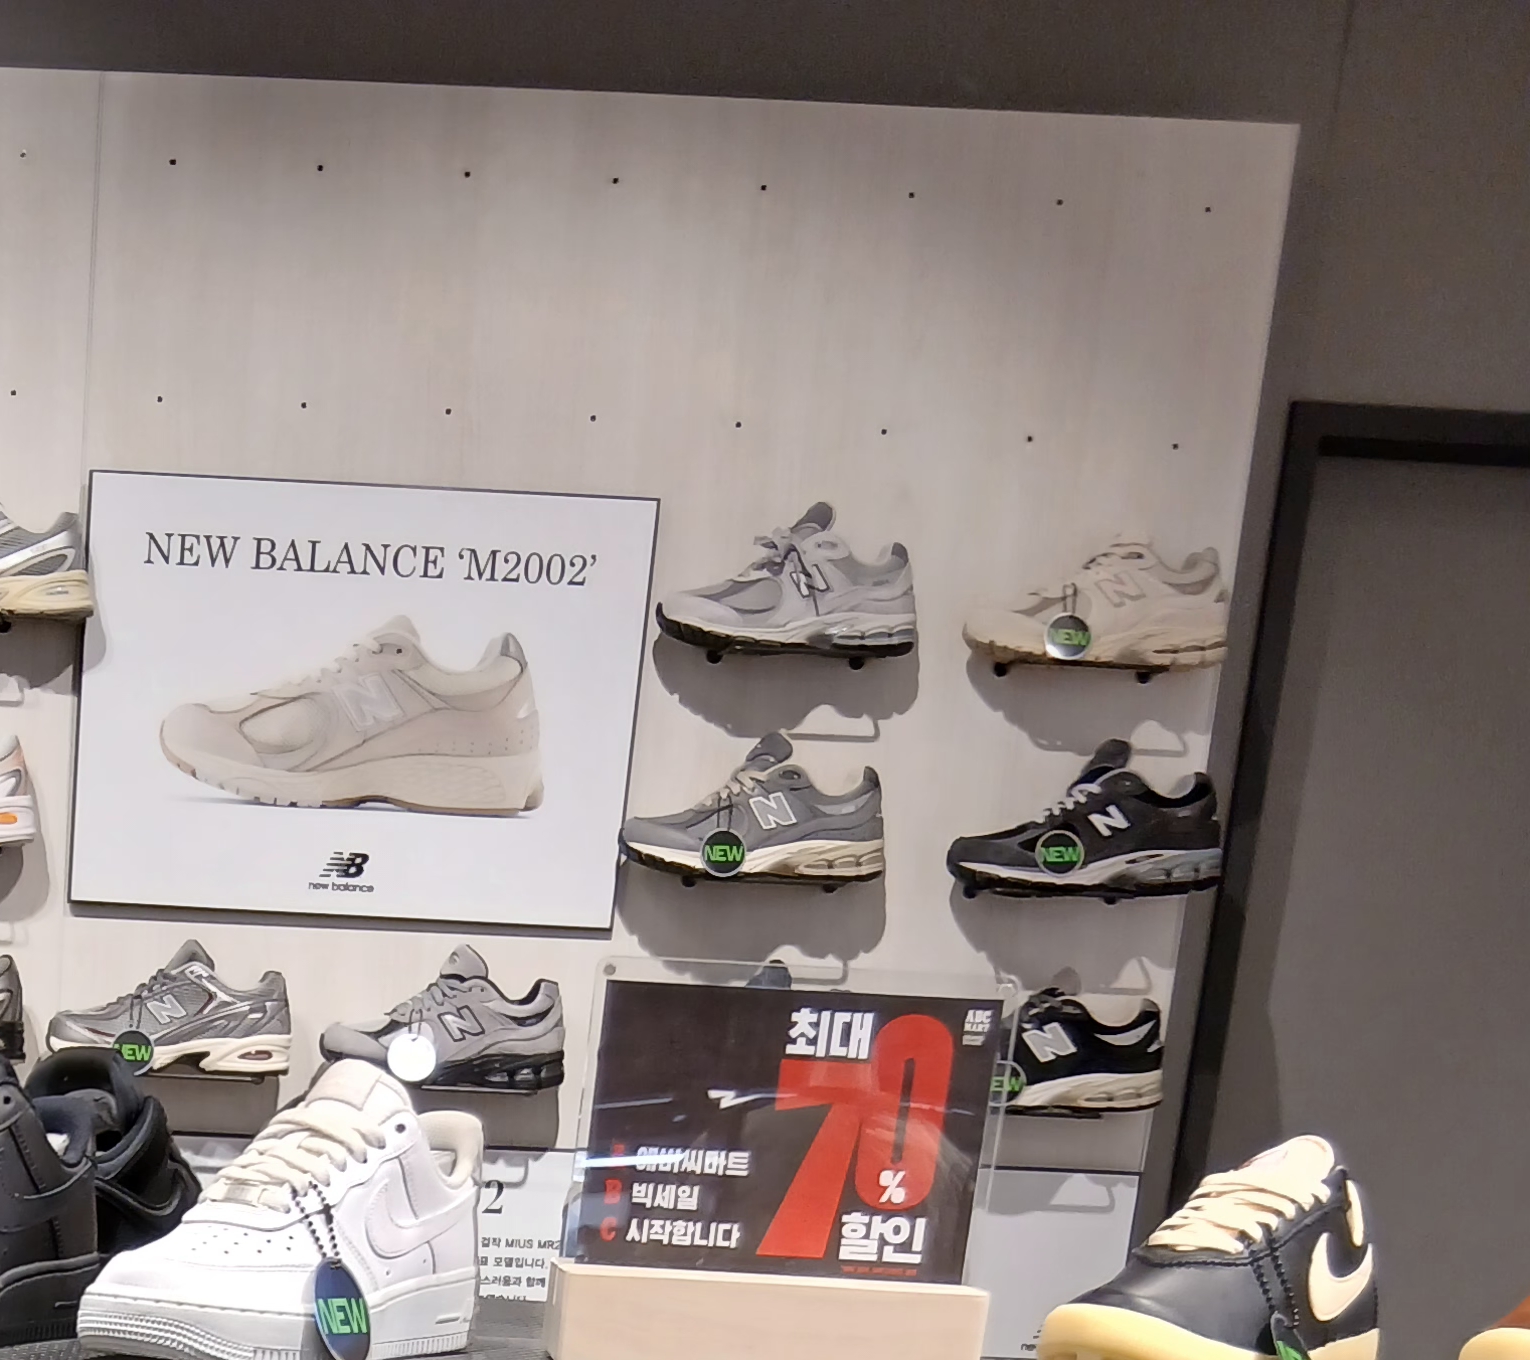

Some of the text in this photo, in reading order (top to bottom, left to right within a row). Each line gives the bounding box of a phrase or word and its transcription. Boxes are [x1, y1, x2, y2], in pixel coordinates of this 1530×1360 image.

[144, 532, 236, 570] NEW
[251, 537, 445, 580] BALANCE
[1048, 628, 1091, 648] NEW
[705, 843, 743, 863] NEW
[1041, 843, 1081, 863] NEW
[331, 880, 374, 893] balance
[785, 1007, 874, 1060] 최대
[116, 1044, 152, 1062] NEW
[989, 1075, 1024, 1092] EW
[631, 1182, 700, 1211] 빅세일
[625, 1217, 741, 1249] 시작합니다
[837, 1212, 927, 1265] 할인
[318, 1297, 369, 1335] NEW
